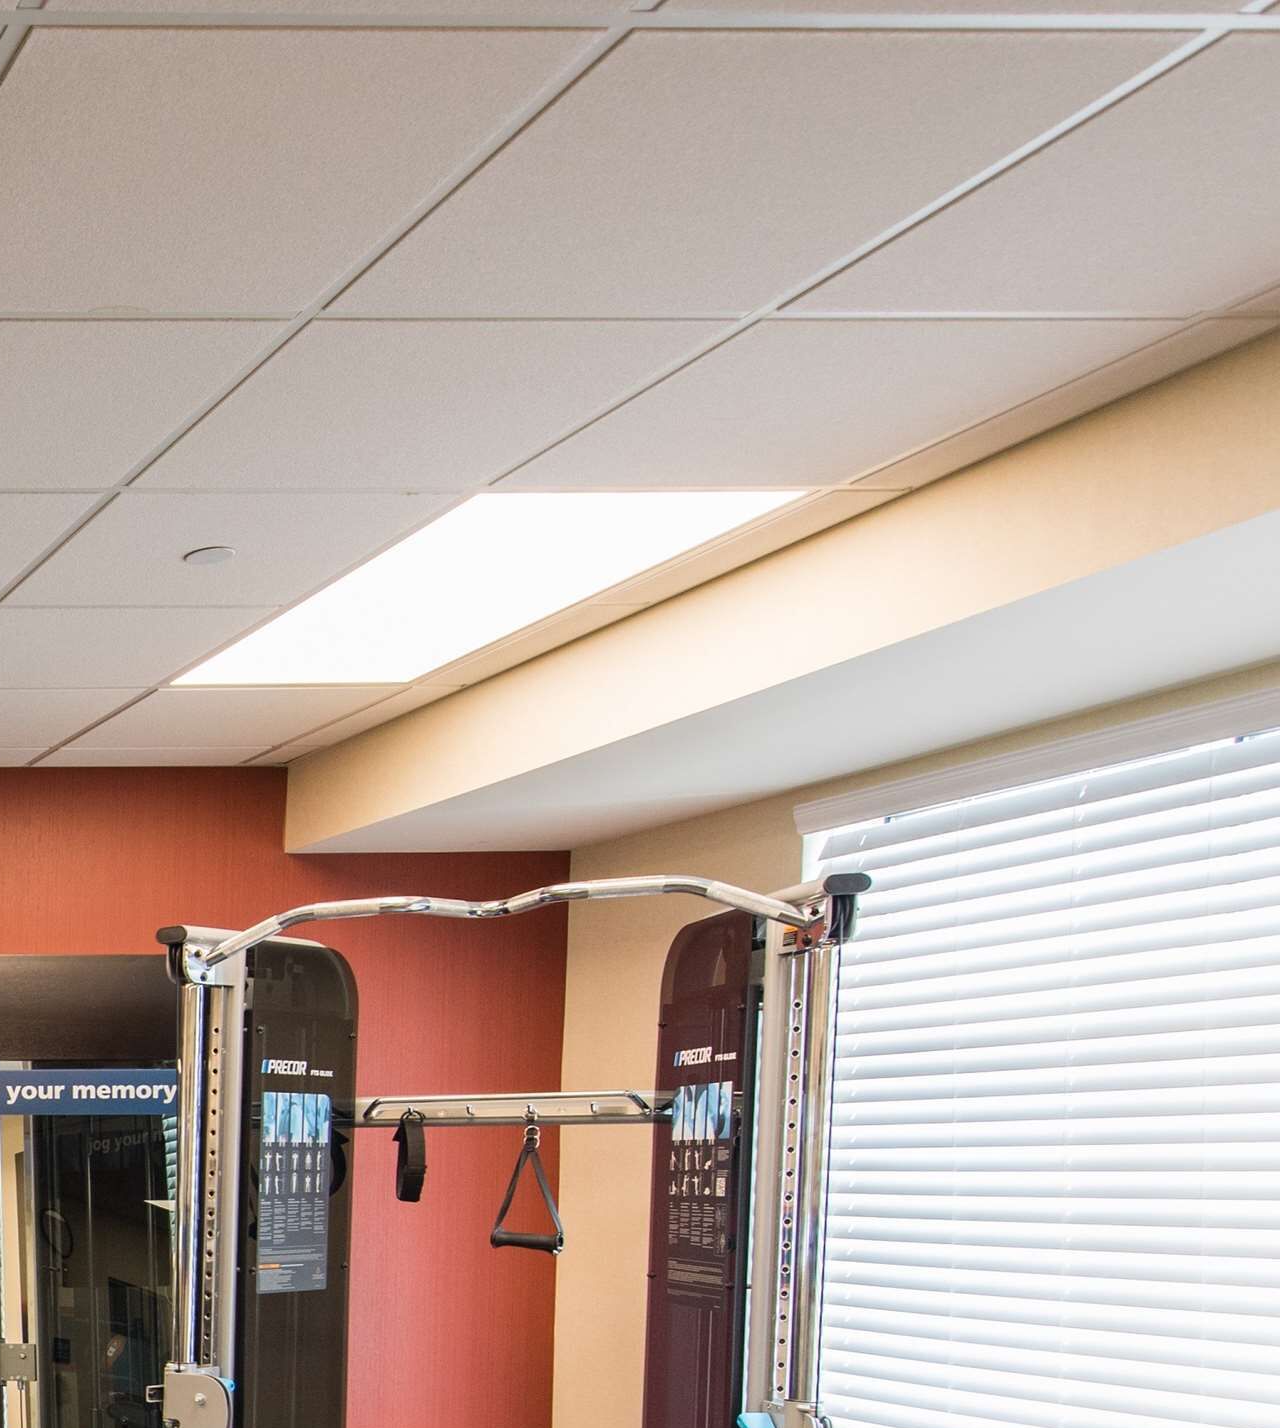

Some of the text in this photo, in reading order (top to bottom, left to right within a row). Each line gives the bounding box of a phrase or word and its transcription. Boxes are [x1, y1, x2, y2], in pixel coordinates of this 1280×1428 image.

[678, 1046, 713, 1067] PRECOR
[267, 1059, 308, 1076] PRECOR
[6, 1084, 65, 1105] your
[72, 1084, 178, 1104] memory
